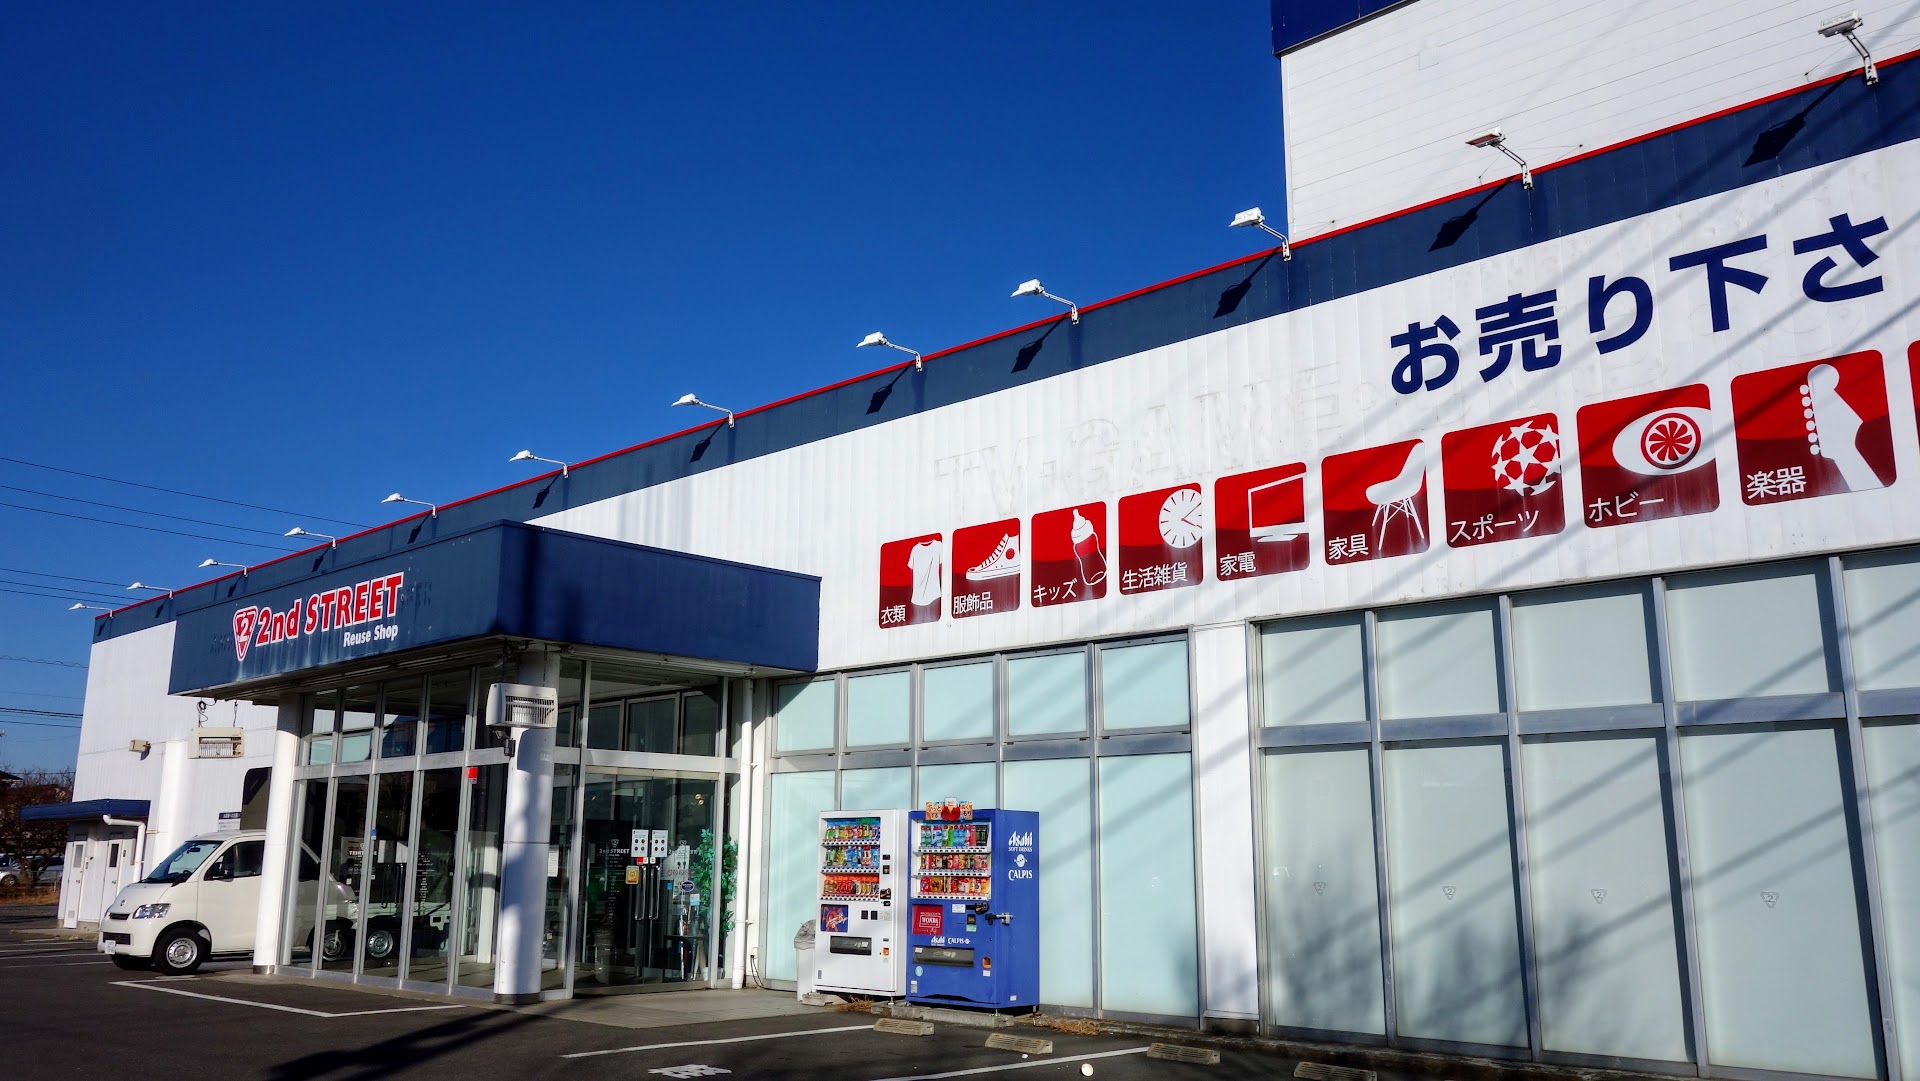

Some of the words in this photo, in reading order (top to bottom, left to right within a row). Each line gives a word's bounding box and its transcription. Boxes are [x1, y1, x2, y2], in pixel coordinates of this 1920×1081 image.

[1390, 212, 1890, 396] お売り下さ
[1746, 466, 1807, 499] 楽器
[1588, 493, 1665, 523] ホビー
[1449, 509, 1540, 544] スポーツ
[1328, 533, 1369, 560] 家具
[1121, 561, 1189, 592] 生活雑貨
[1219, 551, 1257, 577] 家電
[952, 591, 993, 615] 服飾品
[1032, 578, 1079, 603] キッズ
[255, 598, 303, 647] 2nd
[303, 571, 404, 635] STREET
[880, 604, 906, 625] 衣類
[343, 630, 371, 647] Reuse
[373, 623, 399, 641] Shop
[1008, 831, 1033, 846] Asahi
[1008, 869, 1033, 881] CALPIS
[931, 935, 945, 944] Asahi
[947, 937, 964, 945] CALPIS
